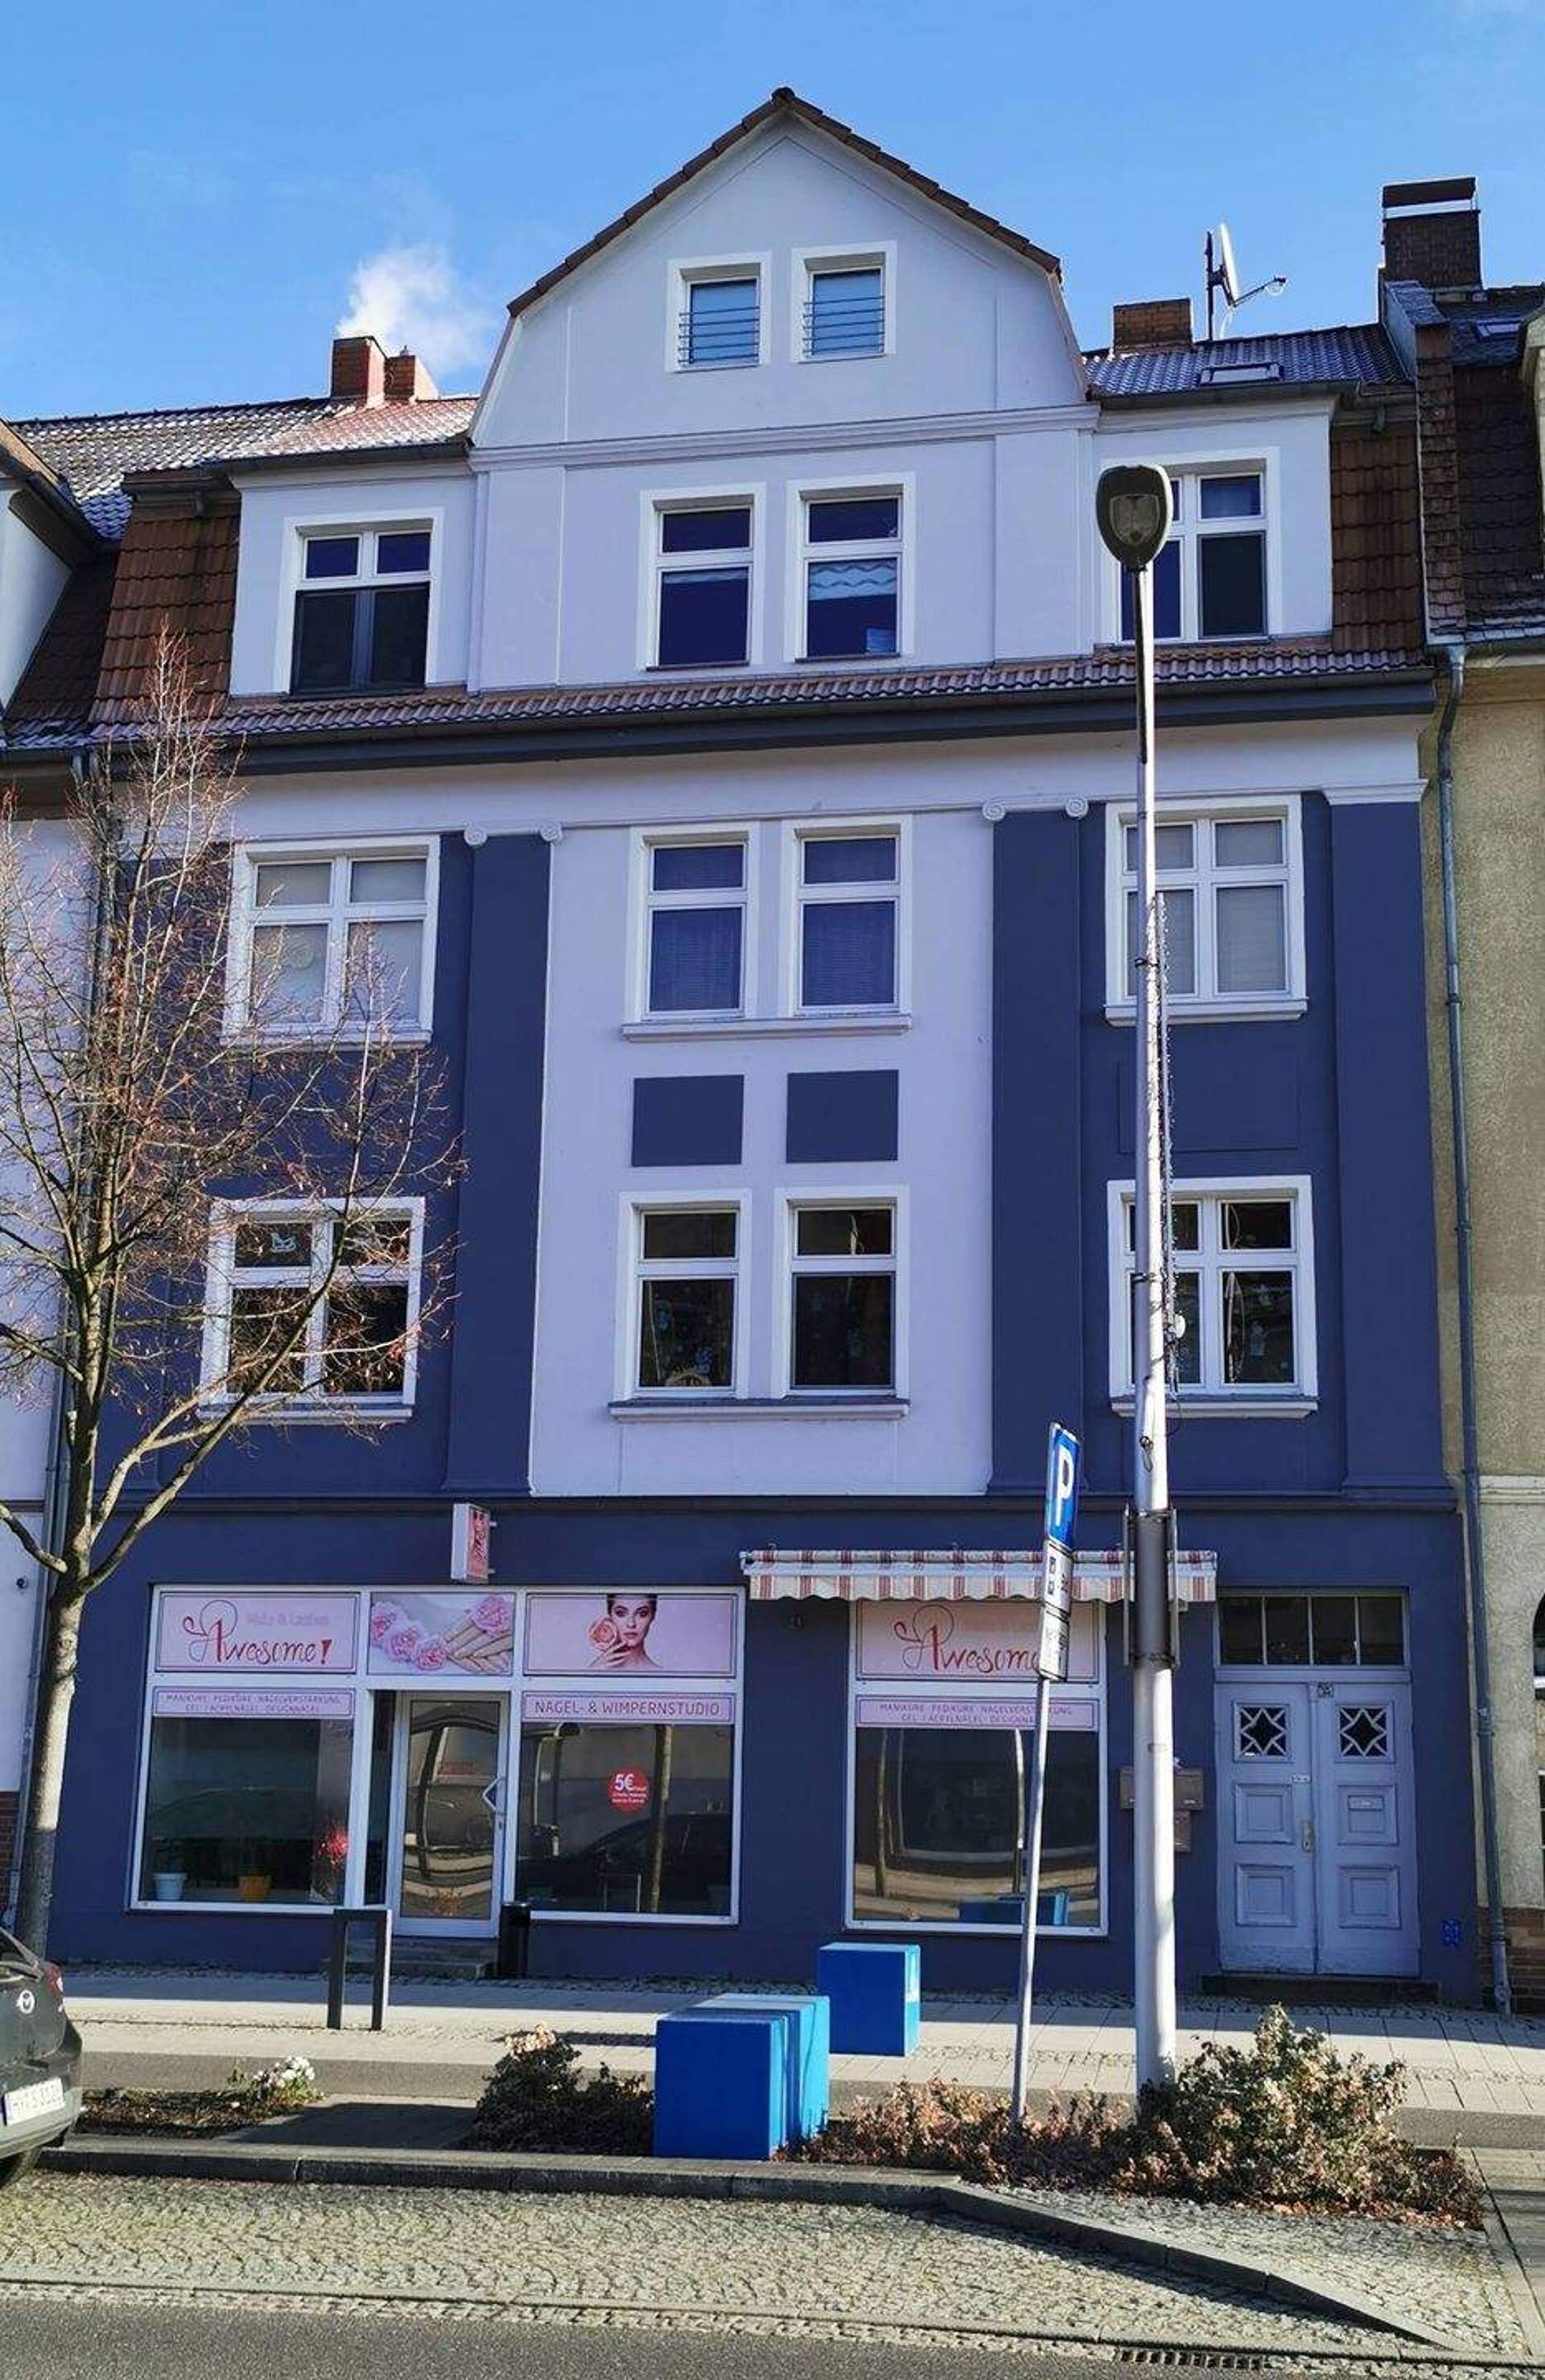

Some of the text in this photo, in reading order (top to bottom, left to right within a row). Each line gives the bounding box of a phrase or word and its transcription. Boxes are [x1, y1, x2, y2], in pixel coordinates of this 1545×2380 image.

[1055, 1444, 1074, 1527] P
[587, 1701, 598, 1714] &
[603, 1701, 720, 1716] WIMPERNSTUDIO
[614, 1773, 635, 1792] 5€
